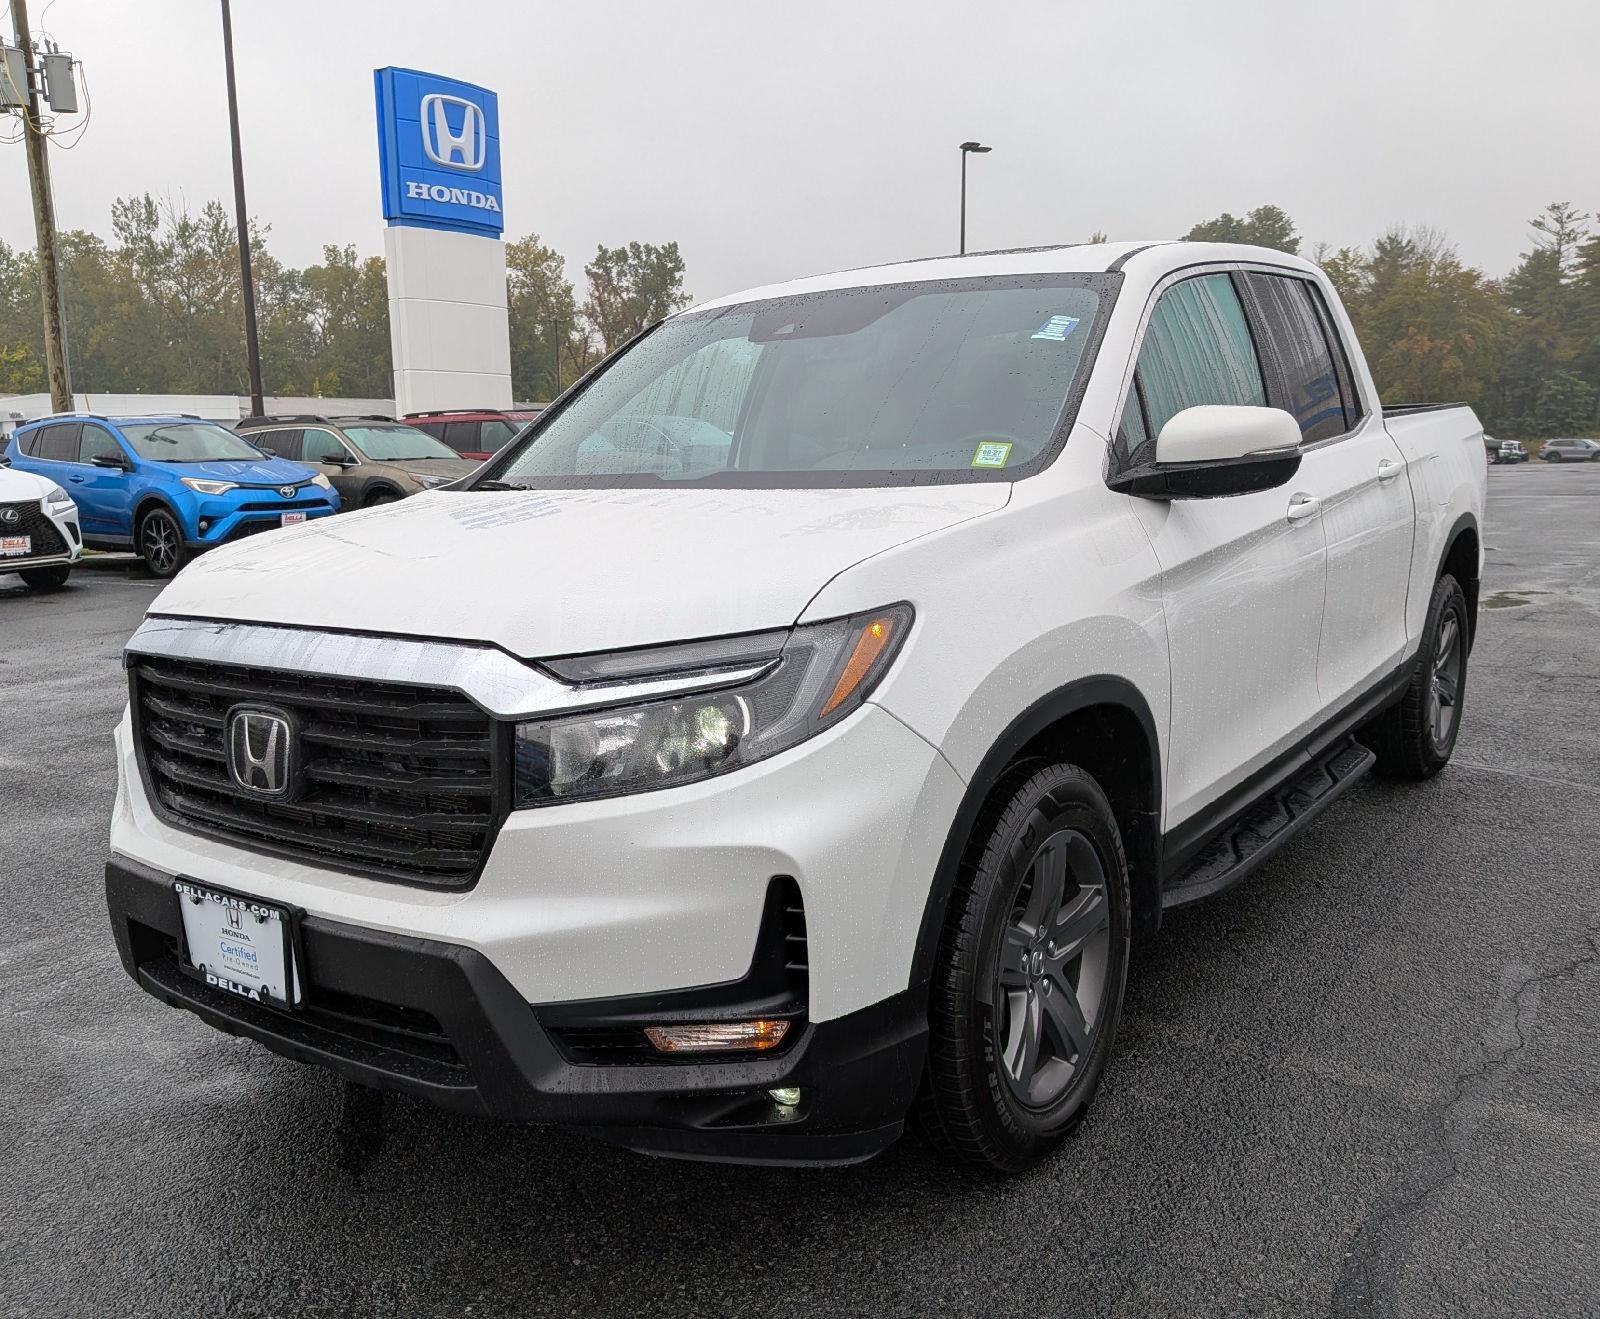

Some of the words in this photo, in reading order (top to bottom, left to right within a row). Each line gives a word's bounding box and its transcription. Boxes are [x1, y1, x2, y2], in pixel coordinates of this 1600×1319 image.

[406, 181, 501, 212] HONDA
[175, 883, 280, 920] DELLACARS.COM
[221, 927, 251, 941] HONDA
[220, 941, 257, 962] Certified
[206, 973, 261, 1002] DELLA
